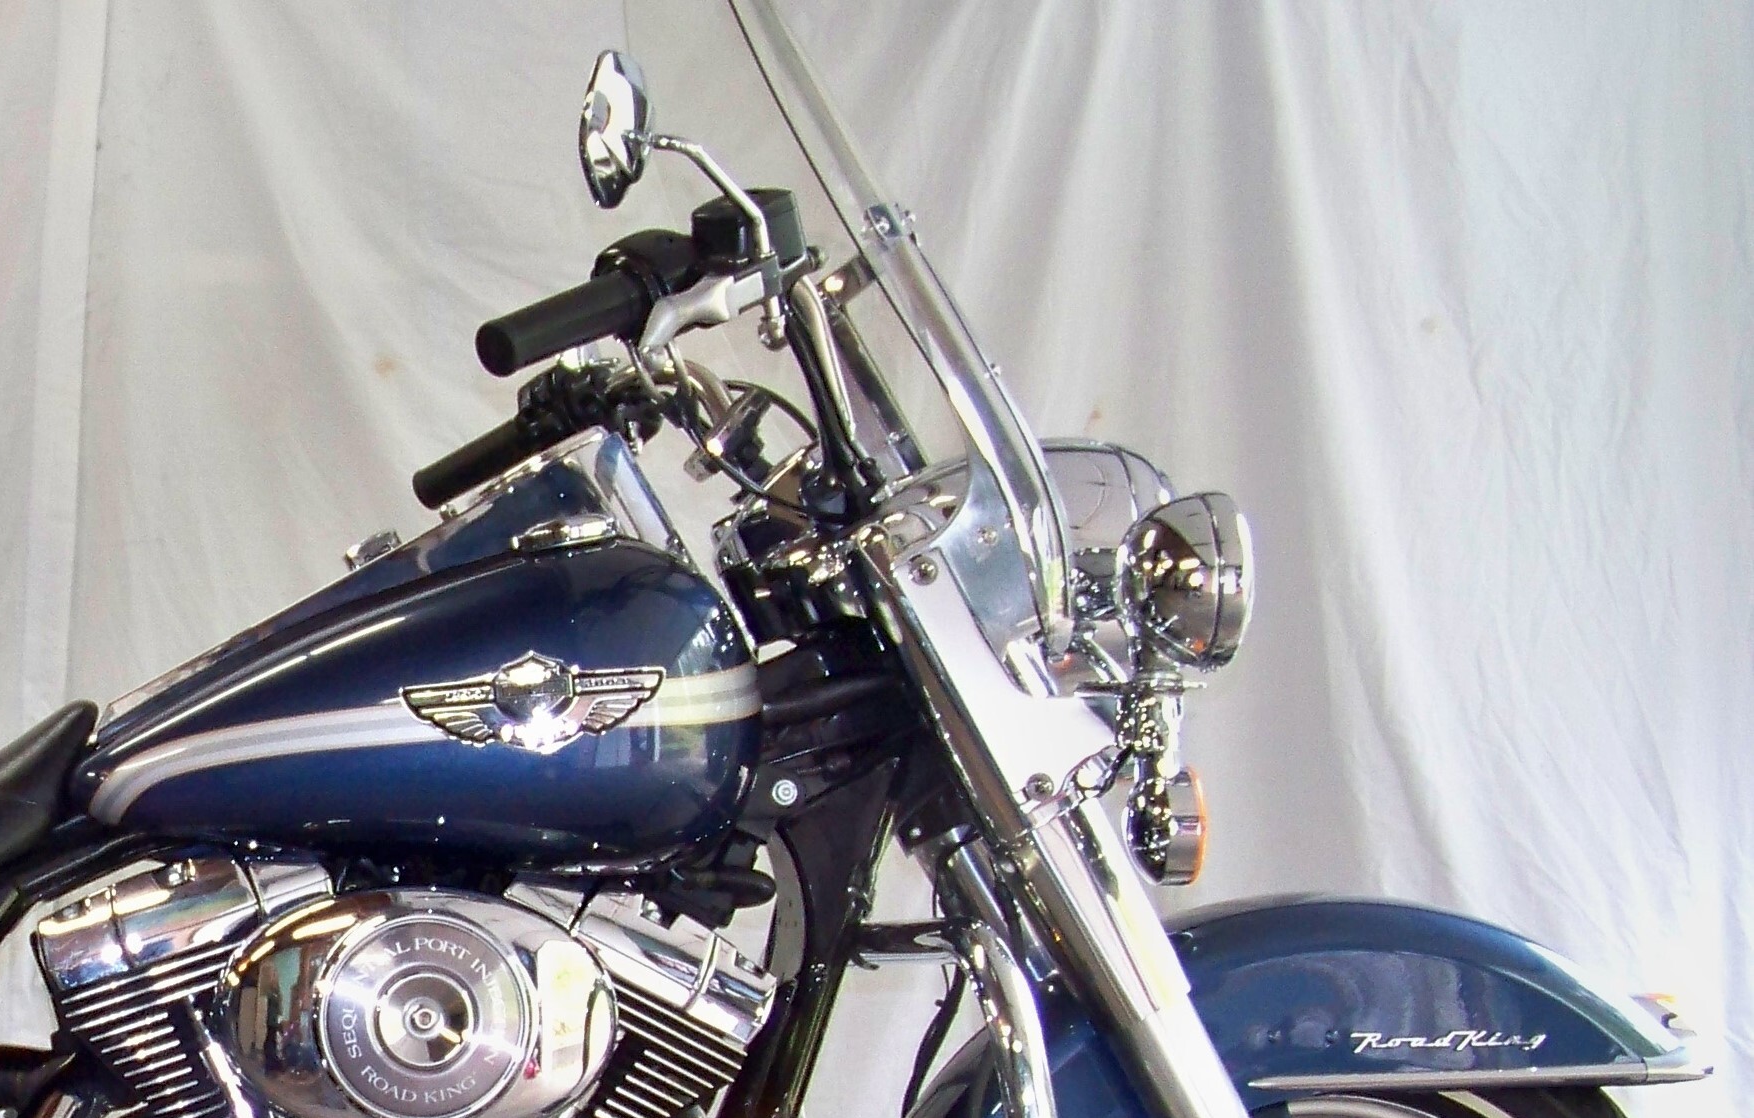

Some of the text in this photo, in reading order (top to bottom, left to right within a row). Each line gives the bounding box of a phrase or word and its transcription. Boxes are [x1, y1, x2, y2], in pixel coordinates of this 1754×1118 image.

[414, 937, 472, 961] PORT
[360, 1065, 477, 1104] ROAD KING
